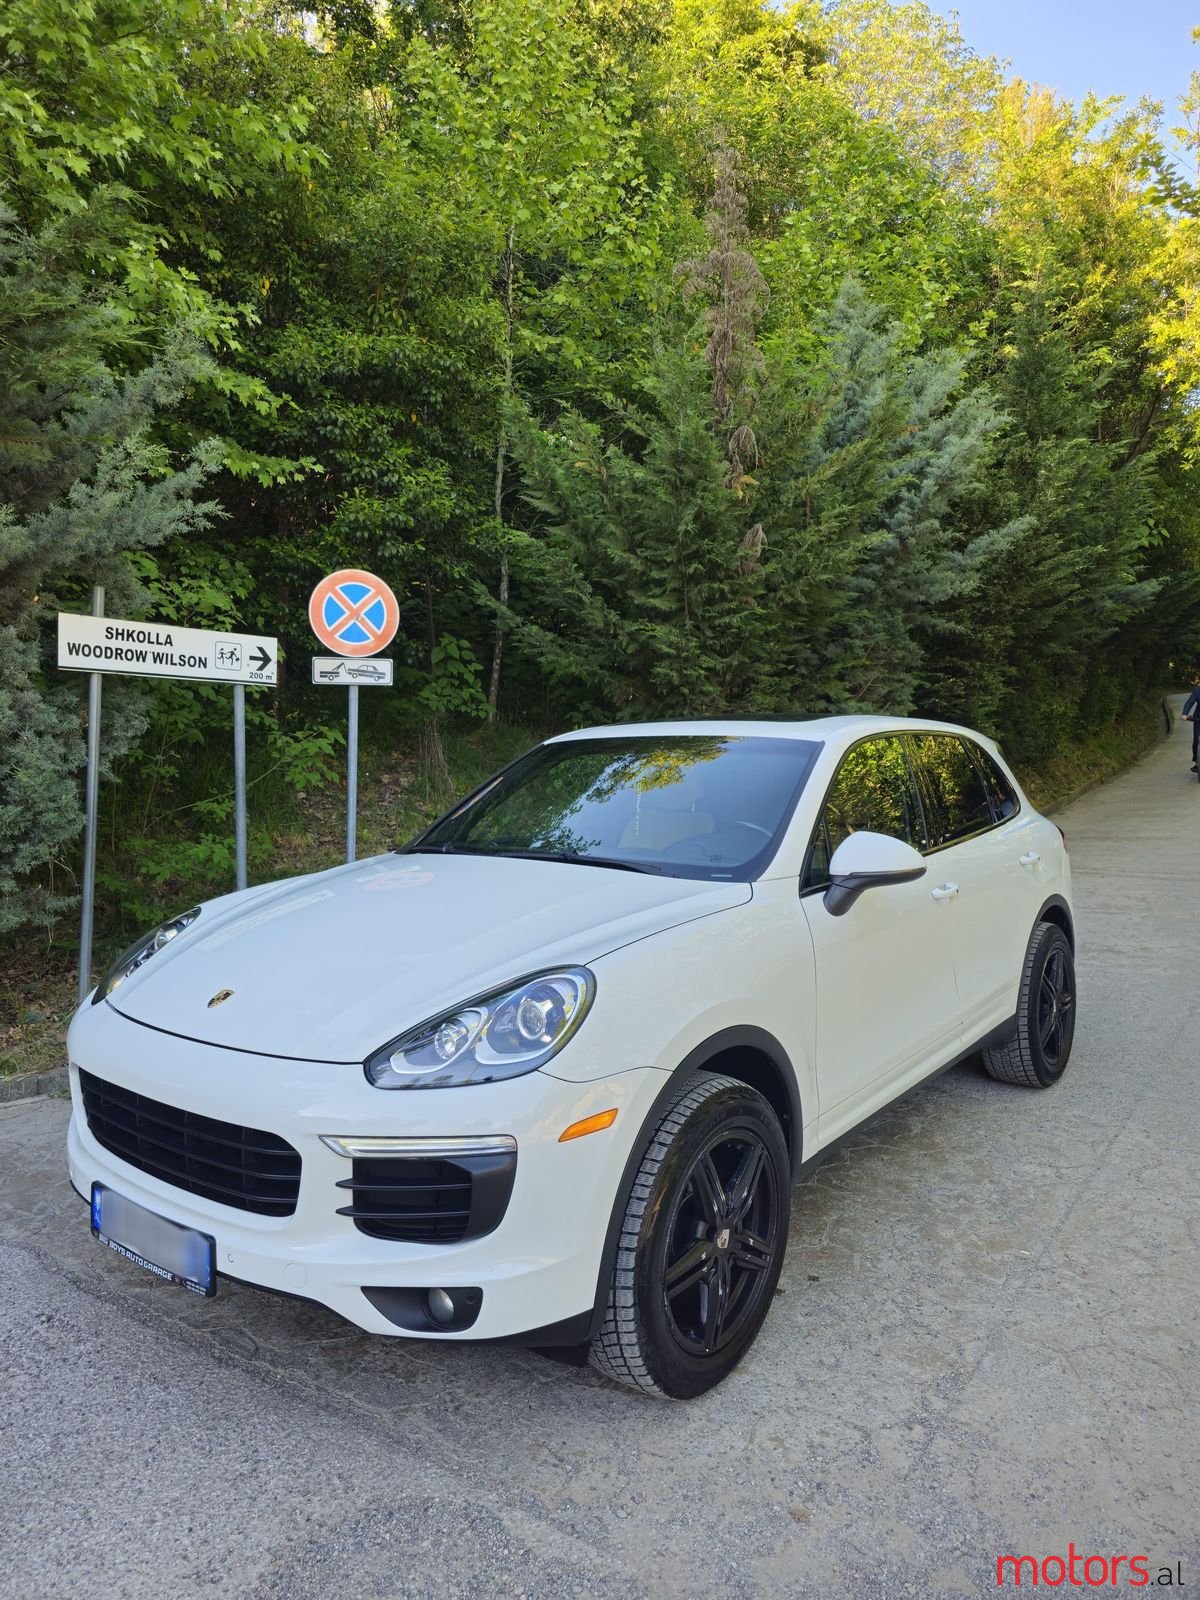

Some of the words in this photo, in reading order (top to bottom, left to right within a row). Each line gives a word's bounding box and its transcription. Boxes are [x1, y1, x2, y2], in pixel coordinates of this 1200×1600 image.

[105, 627, 173, 646] SHKOLLA
[67, 642, 148, 662] WOODROW
[152, 652, 207, 668] WILSON
[249, 672, 264, 680] 200
[109, 1241, 125, 1256] BOYS
